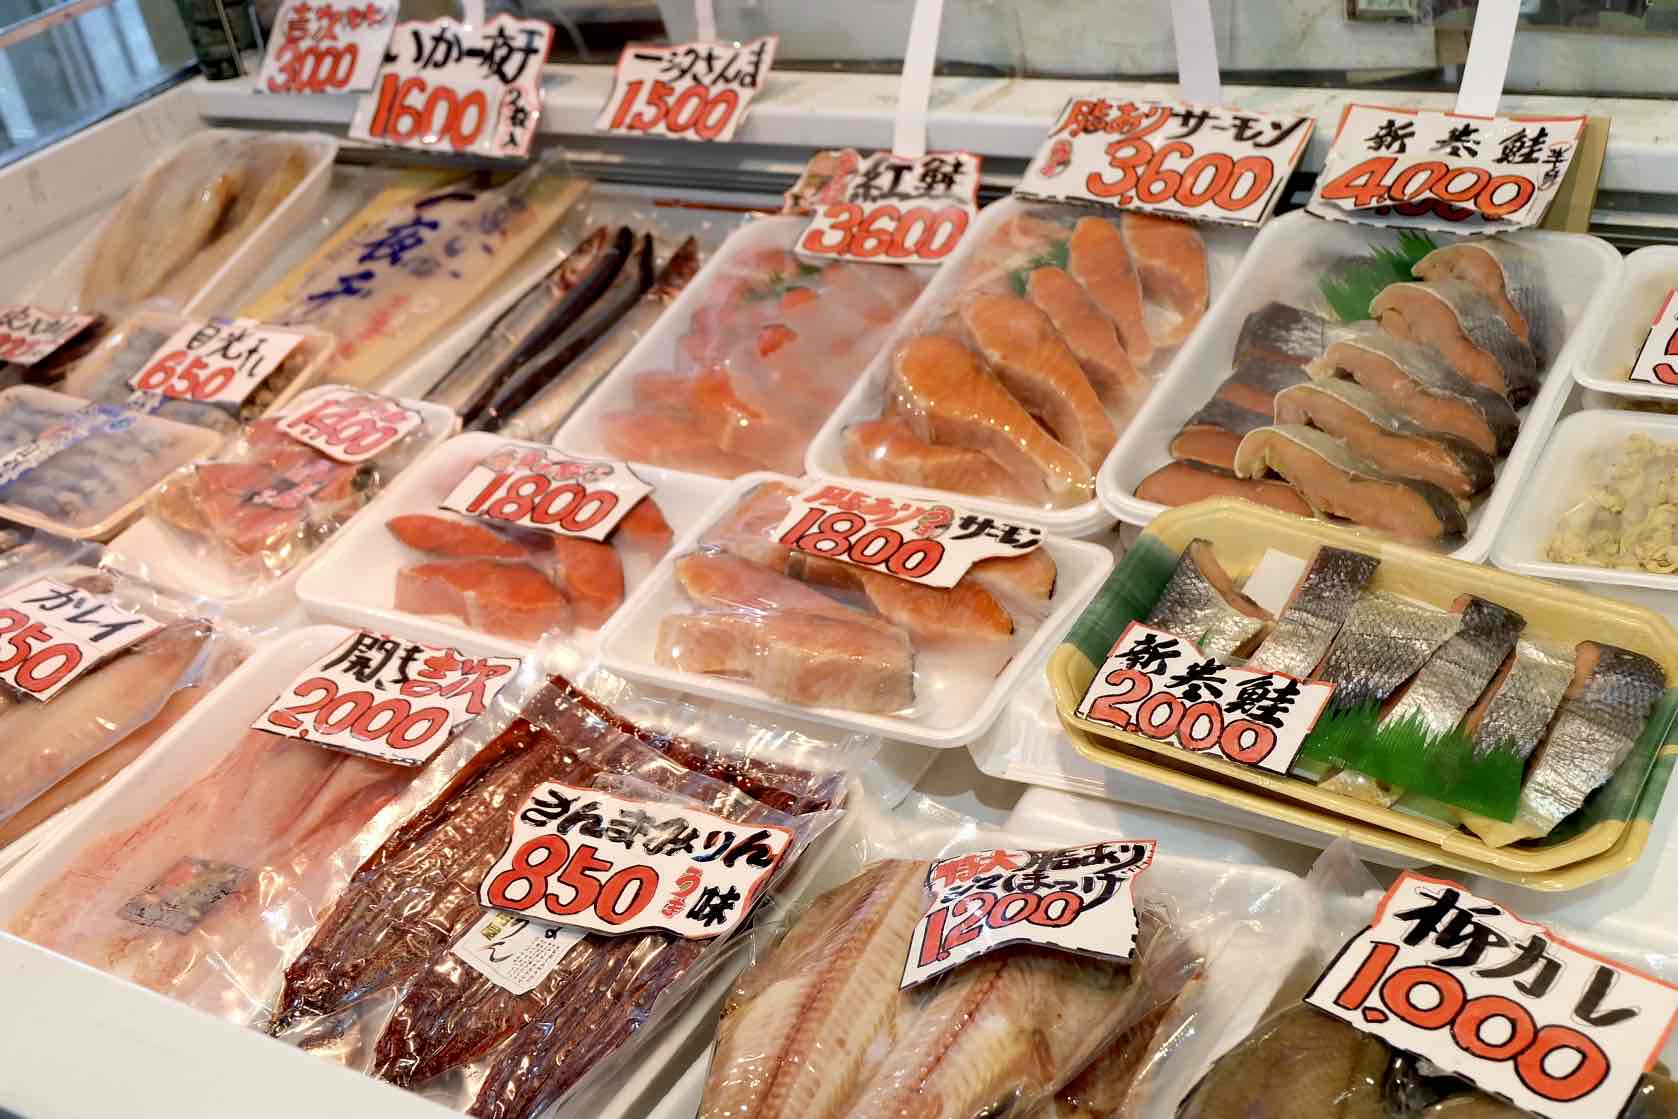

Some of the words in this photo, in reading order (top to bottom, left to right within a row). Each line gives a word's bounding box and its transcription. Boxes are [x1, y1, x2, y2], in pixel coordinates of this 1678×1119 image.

[849, 155, 965, 202] 紅鮭
[137, 350, 236, 400] 650
[487, 833, 660, 926] 850
